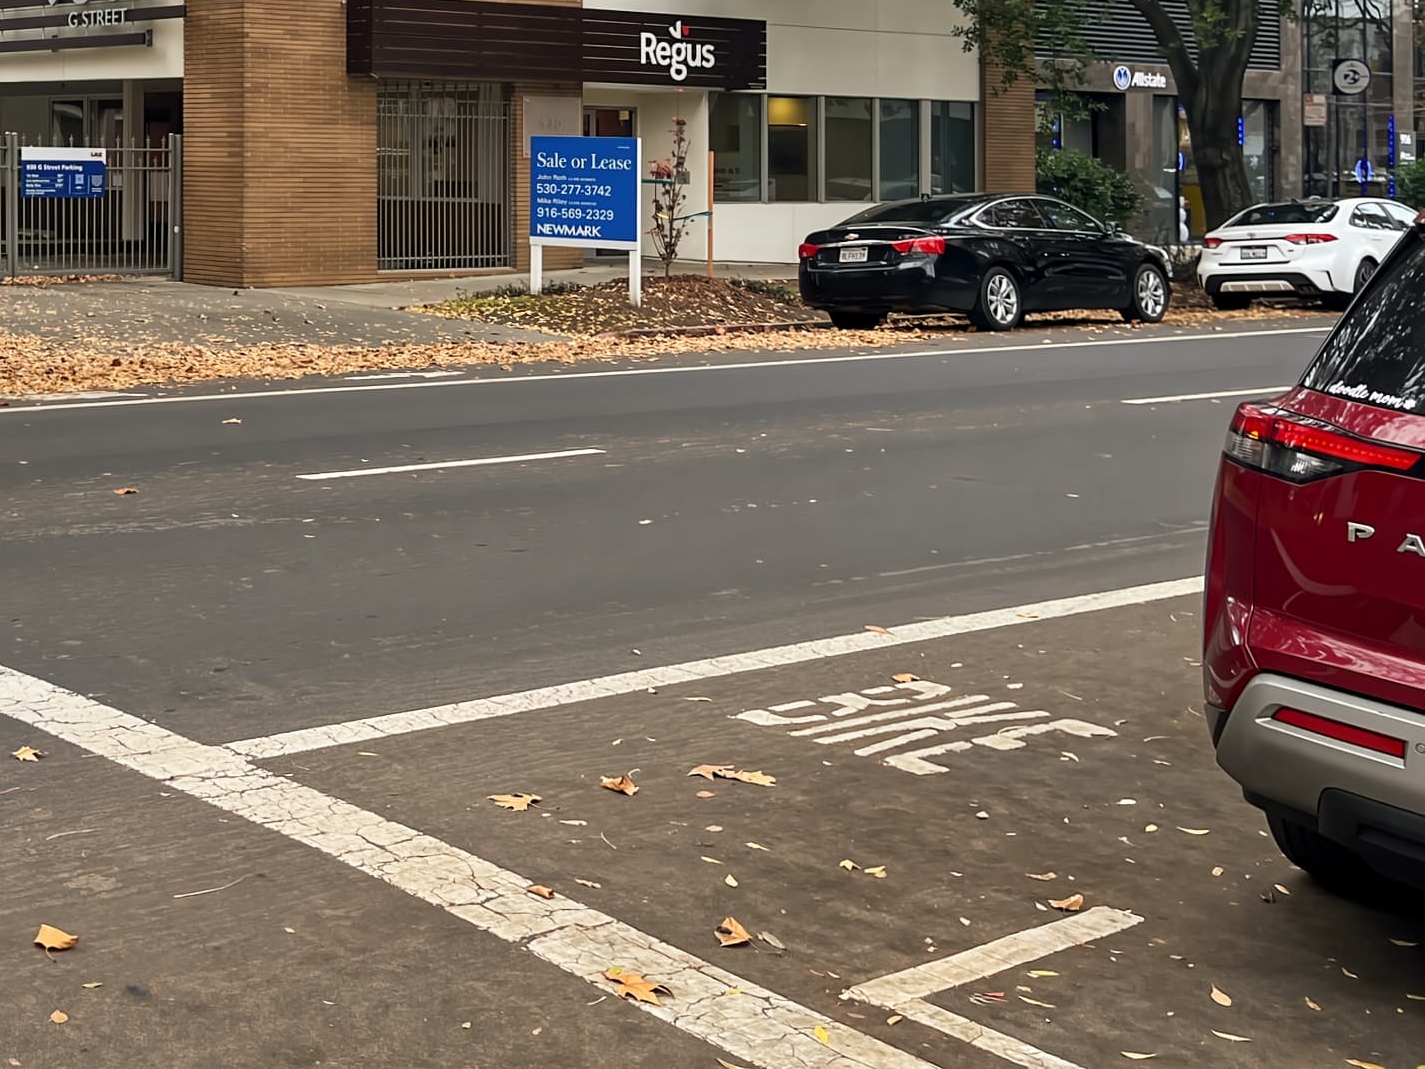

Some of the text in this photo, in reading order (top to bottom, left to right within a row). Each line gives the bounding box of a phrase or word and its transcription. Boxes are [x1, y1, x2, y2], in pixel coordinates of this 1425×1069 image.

[68, 8, 127, 29] G STREET
[640, 32, 715, 81] Regus
[1131, 72, 1167, 88] Allstate
[61, 164, 83, 172] Parking
[537, 152, 632, 171] Sale or Lease
[536, 183, 612, 197] 530-277-3742
[536, 207, 614, 221] 916-569-2329
[537, 223, 602, 238] NEWMARK
[1328, 380, 1404, 409] doodle mom
[728, 680, 1118, 776] BIKE
